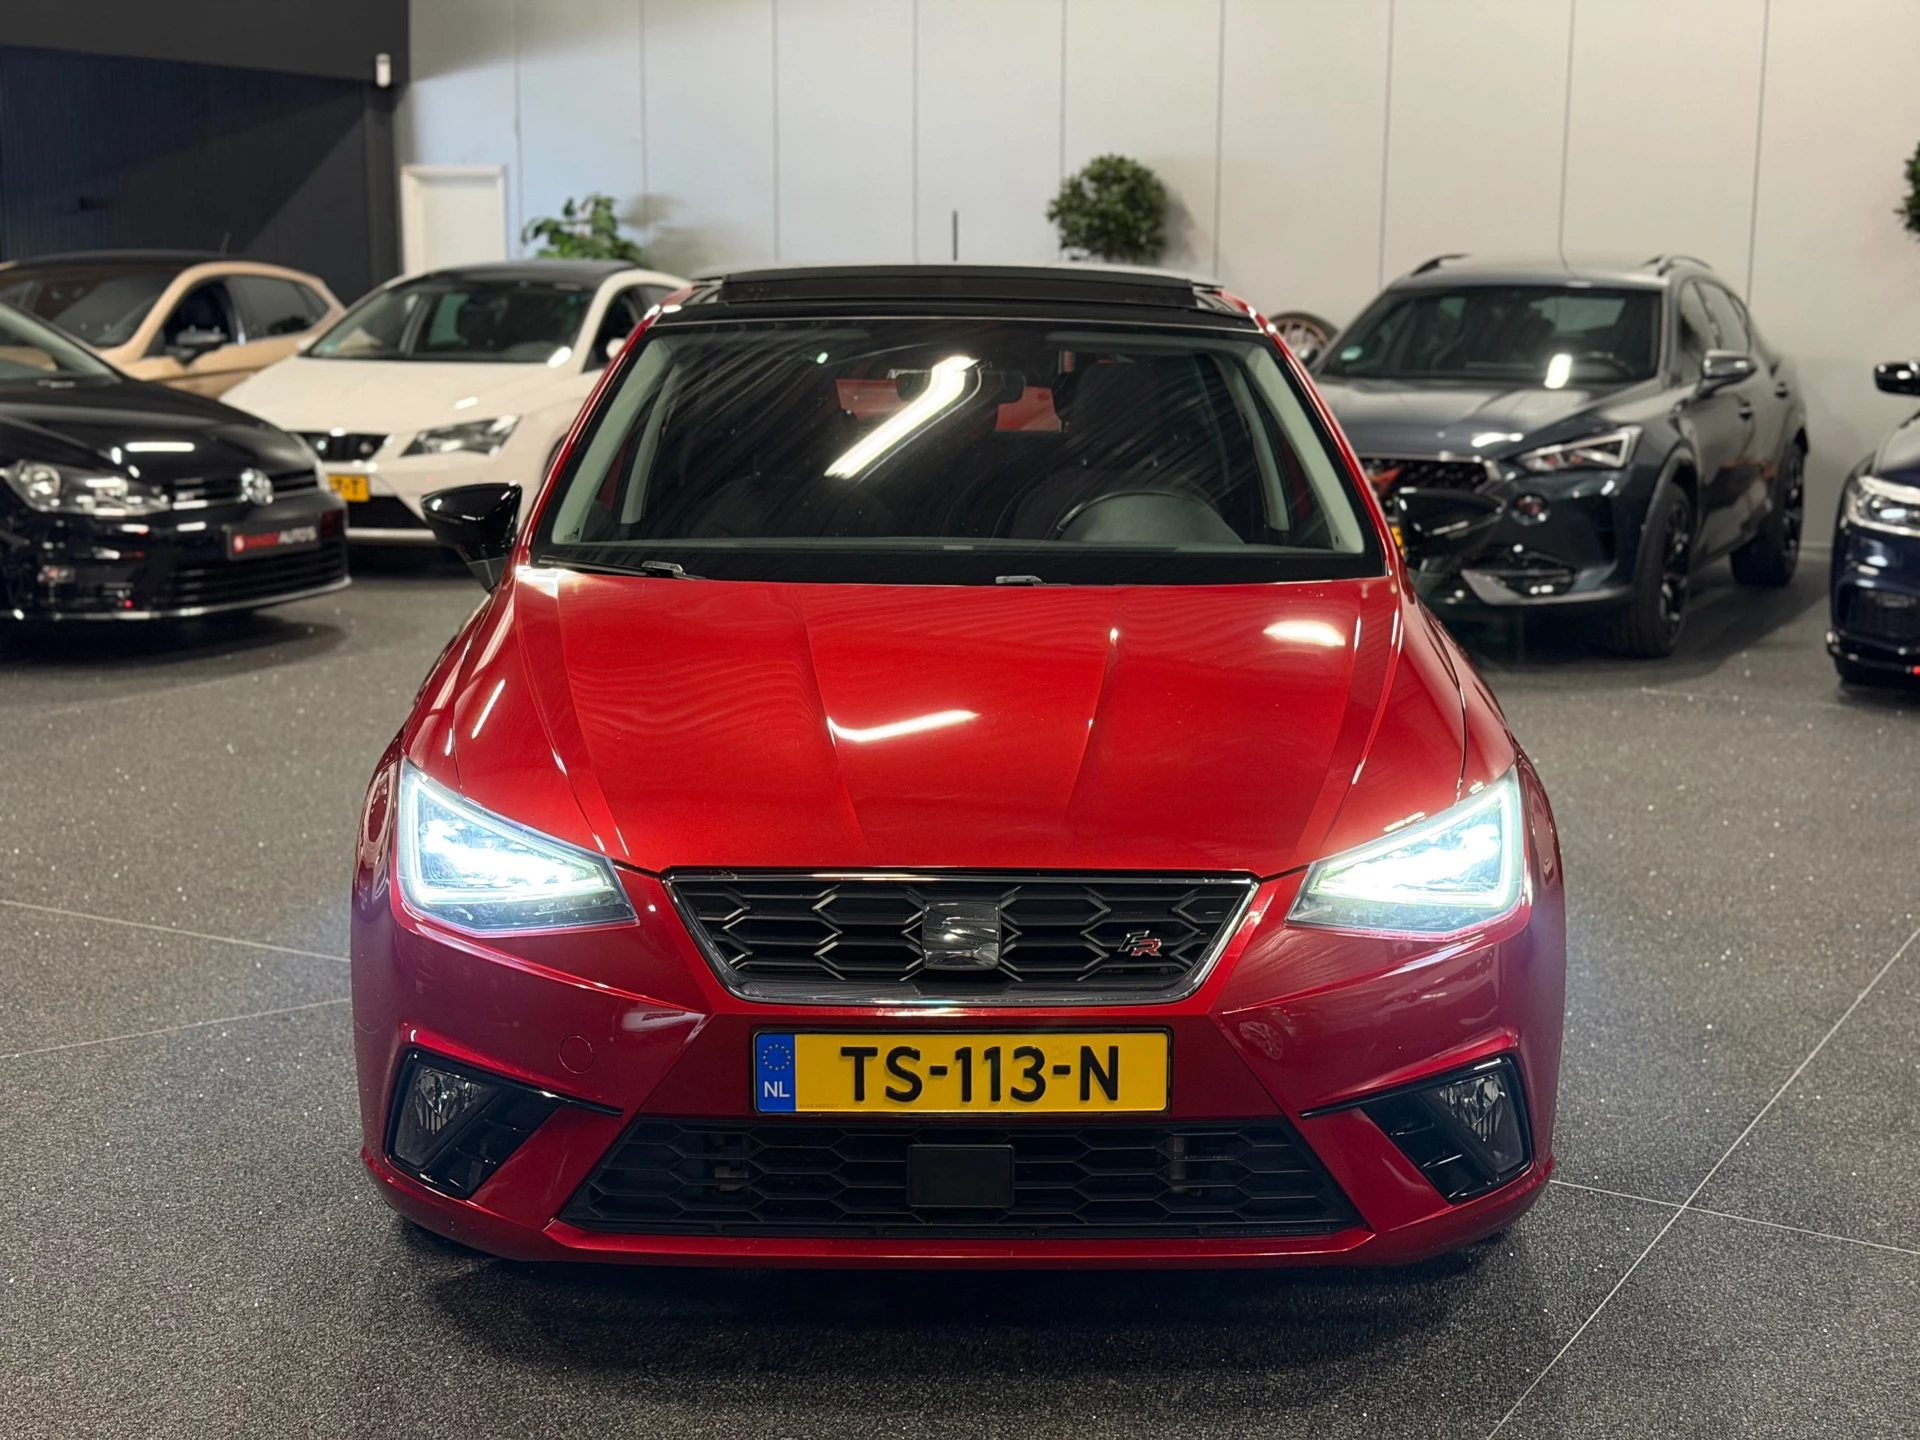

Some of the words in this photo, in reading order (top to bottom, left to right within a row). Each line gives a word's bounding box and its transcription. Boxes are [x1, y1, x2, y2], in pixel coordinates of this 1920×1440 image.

[1116, 930, 1162, 957] FR
[840, 1045, 1120, 1103] TS-113-N
[763, 1080, 791, 1098] NL
